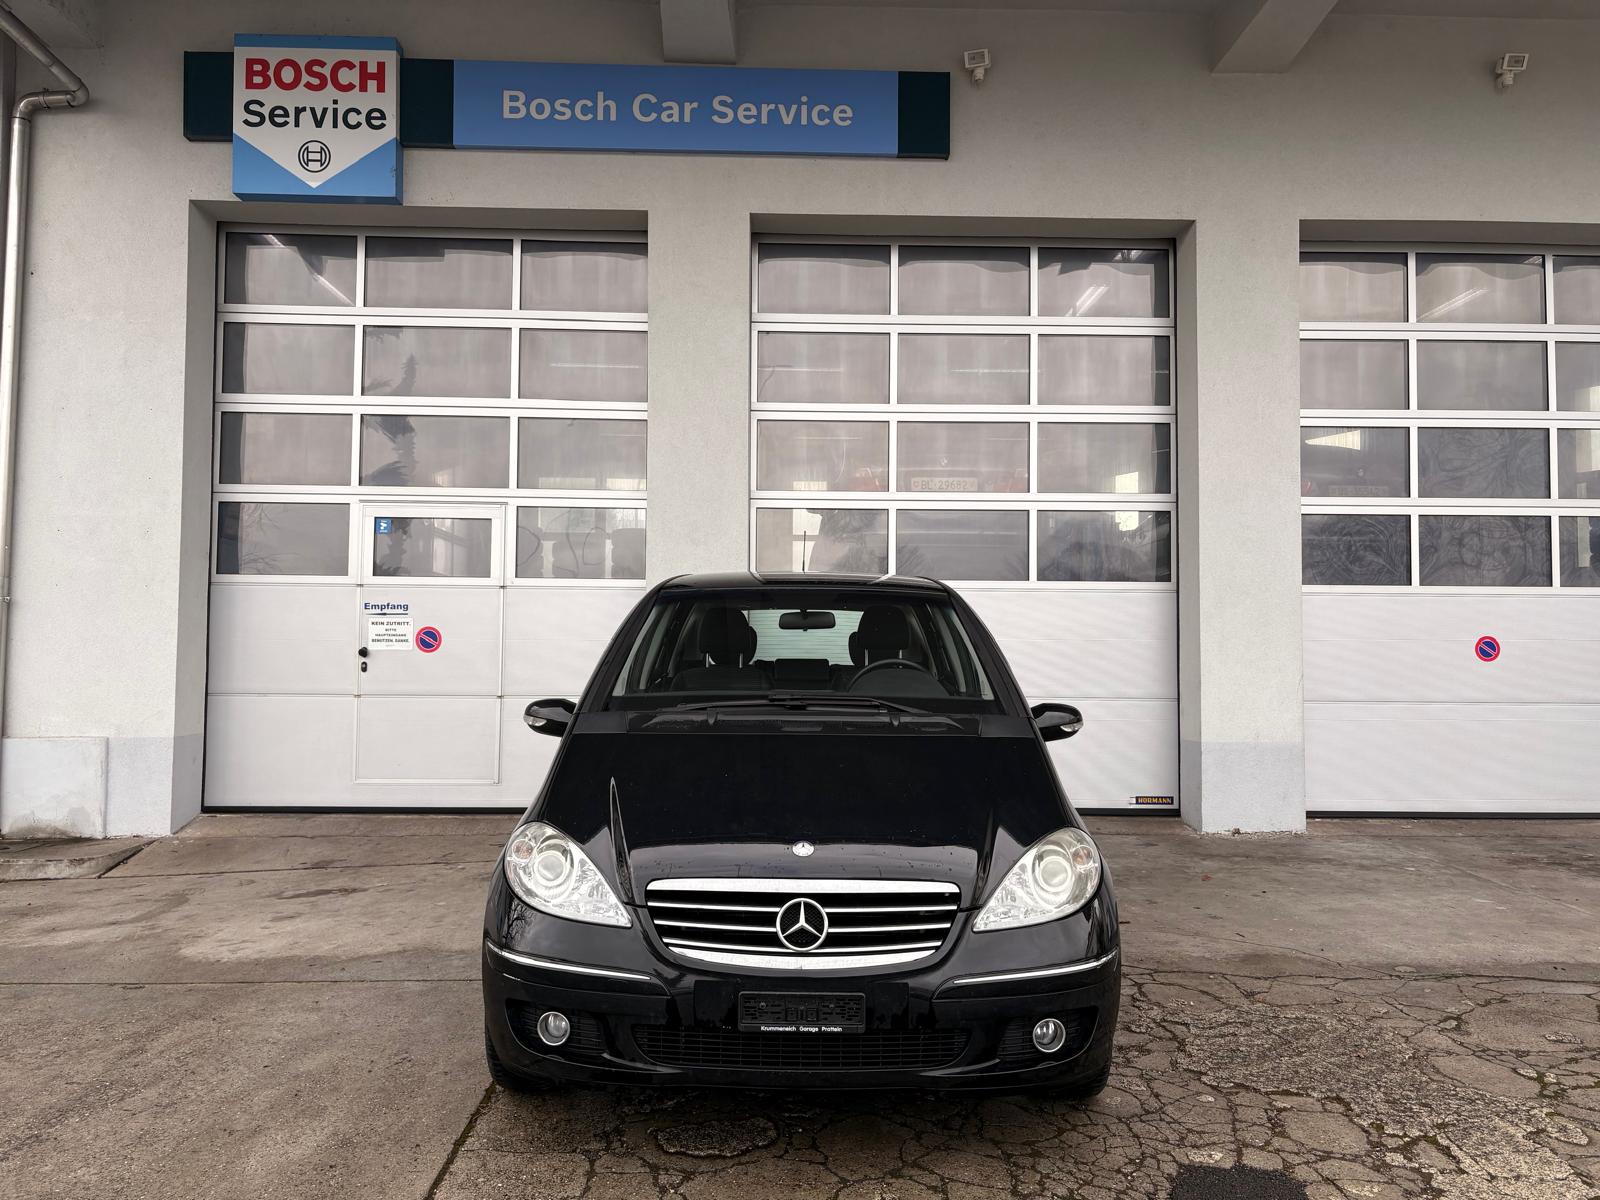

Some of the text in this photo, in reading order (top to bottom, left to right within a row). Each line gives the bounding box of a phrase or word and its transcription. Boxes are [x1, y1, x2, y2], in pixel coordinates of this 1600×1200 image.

[244, 57, 386, 93] BOSCH
[242, 99, 387, 130] Service
[502, 89, 854, 127] Bosch Car Service
[364, 602, 409, 612] Empfang
